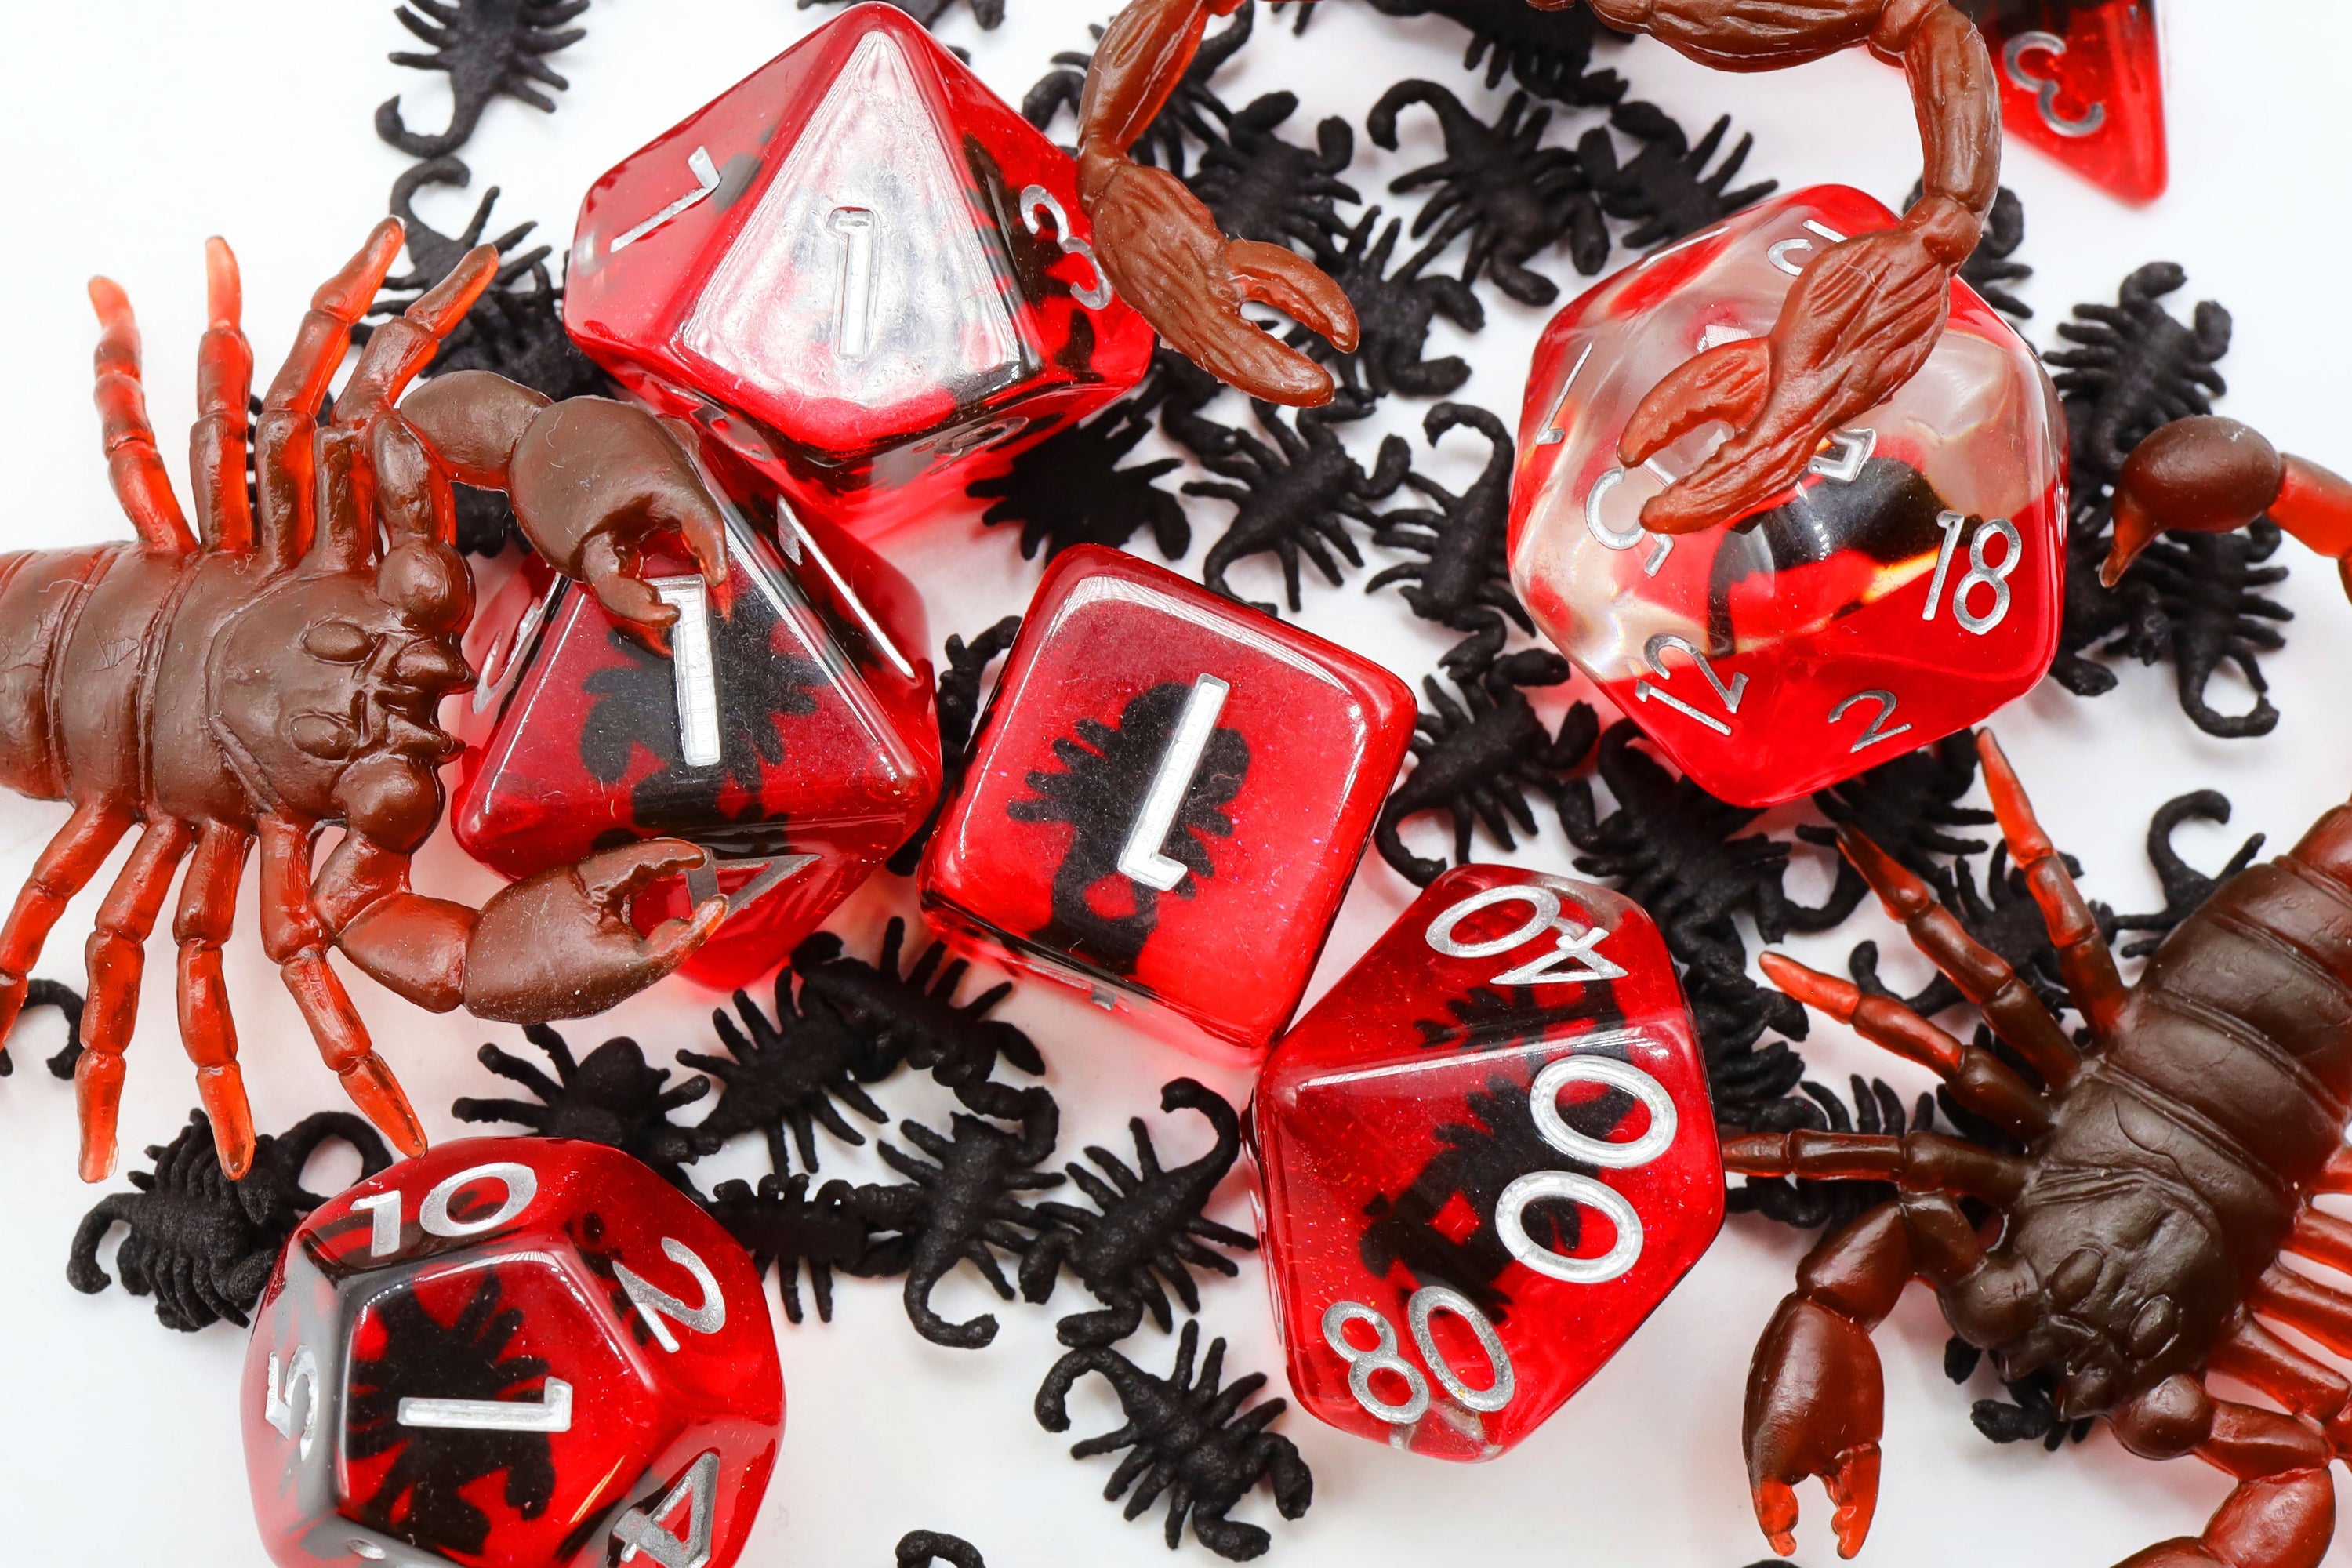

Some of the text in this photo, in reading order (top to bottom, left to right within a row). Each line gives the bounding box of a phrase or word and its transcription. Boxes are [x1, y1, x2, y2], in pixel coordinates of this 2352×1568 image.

[826, 207, 875, 359] 1
[1020, 183, 1113, 310] 3
[1922, 510, 2023, 635] 18
[649, 573, 720, 766] 1
[1635, 633, 1749, 736] 12
[1828, 689, 1913, 753] 2
[1117, 673, 1230, 891] 1
[1425, 885, 1629, 985] 40
[350, 1162, 538, 1257] 10
[1495, 1054, 1678, 1283] 00
[612, 1236, 726, 1354] 2
[1322, 1285, 1515, 1423] 80
[265, 1345, 318, 1462] 5
[397, 1376, 572, 1432] 1
[612, 1450, 720, 1568] 4
